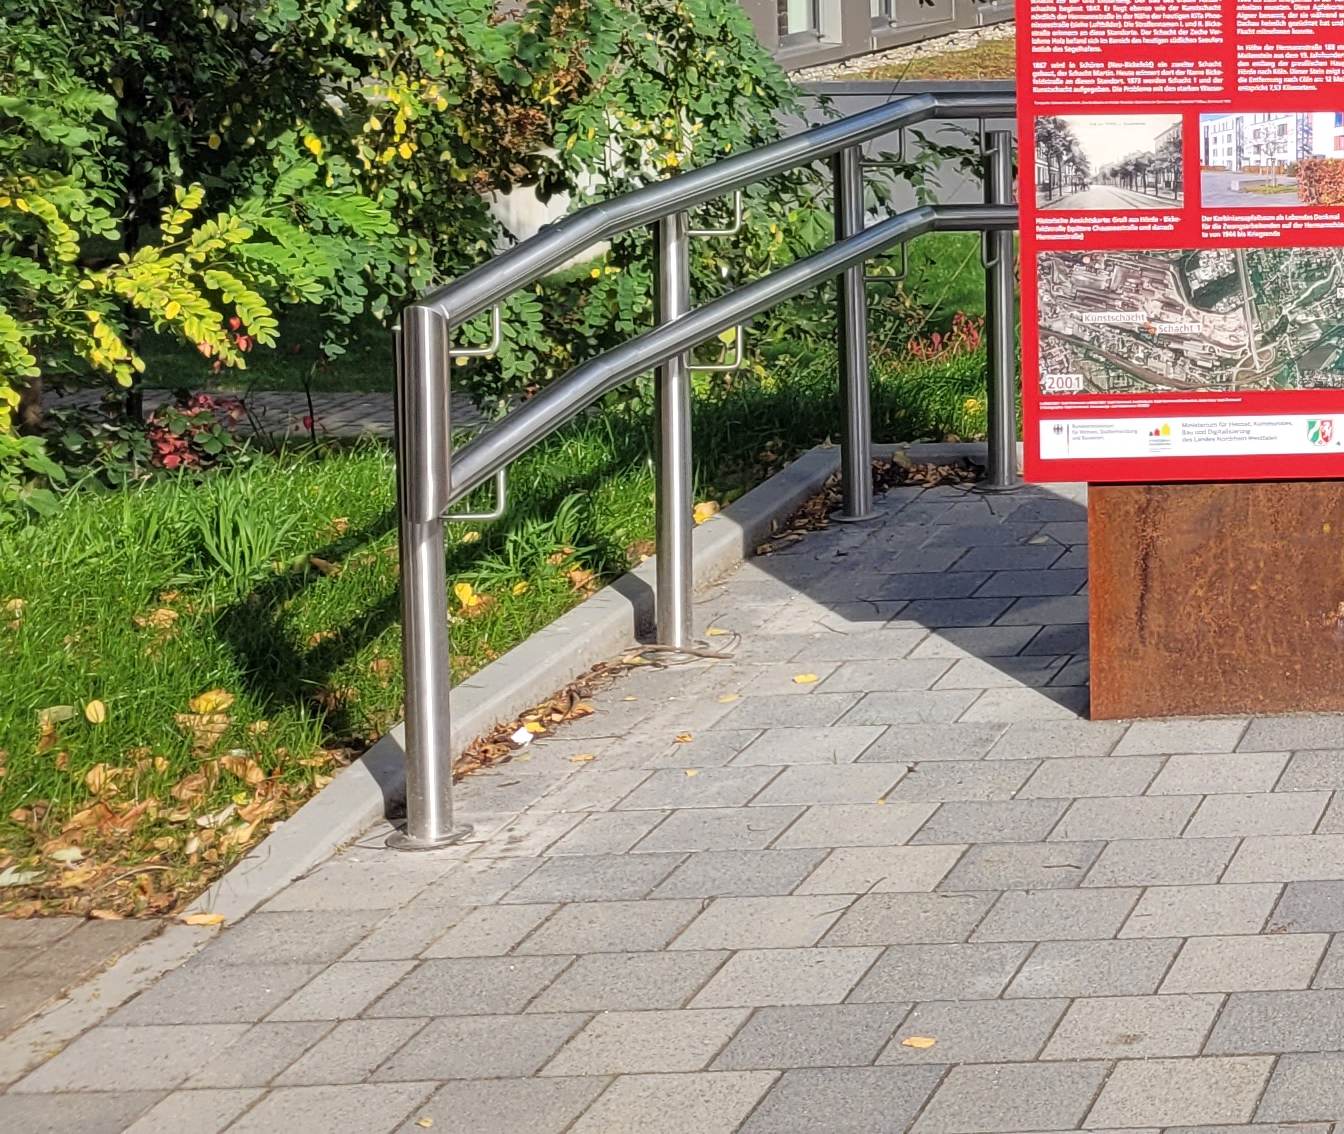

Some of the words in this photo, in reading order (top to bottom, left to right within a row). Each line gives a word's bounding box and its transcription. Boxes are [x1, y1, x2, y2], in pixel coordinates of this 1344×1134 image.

[1084, 313, 1145, 322] Kunstschacht
[1158, 324, 1194, 333] Schacht
[1048, 377, 1081, 389] 2001
